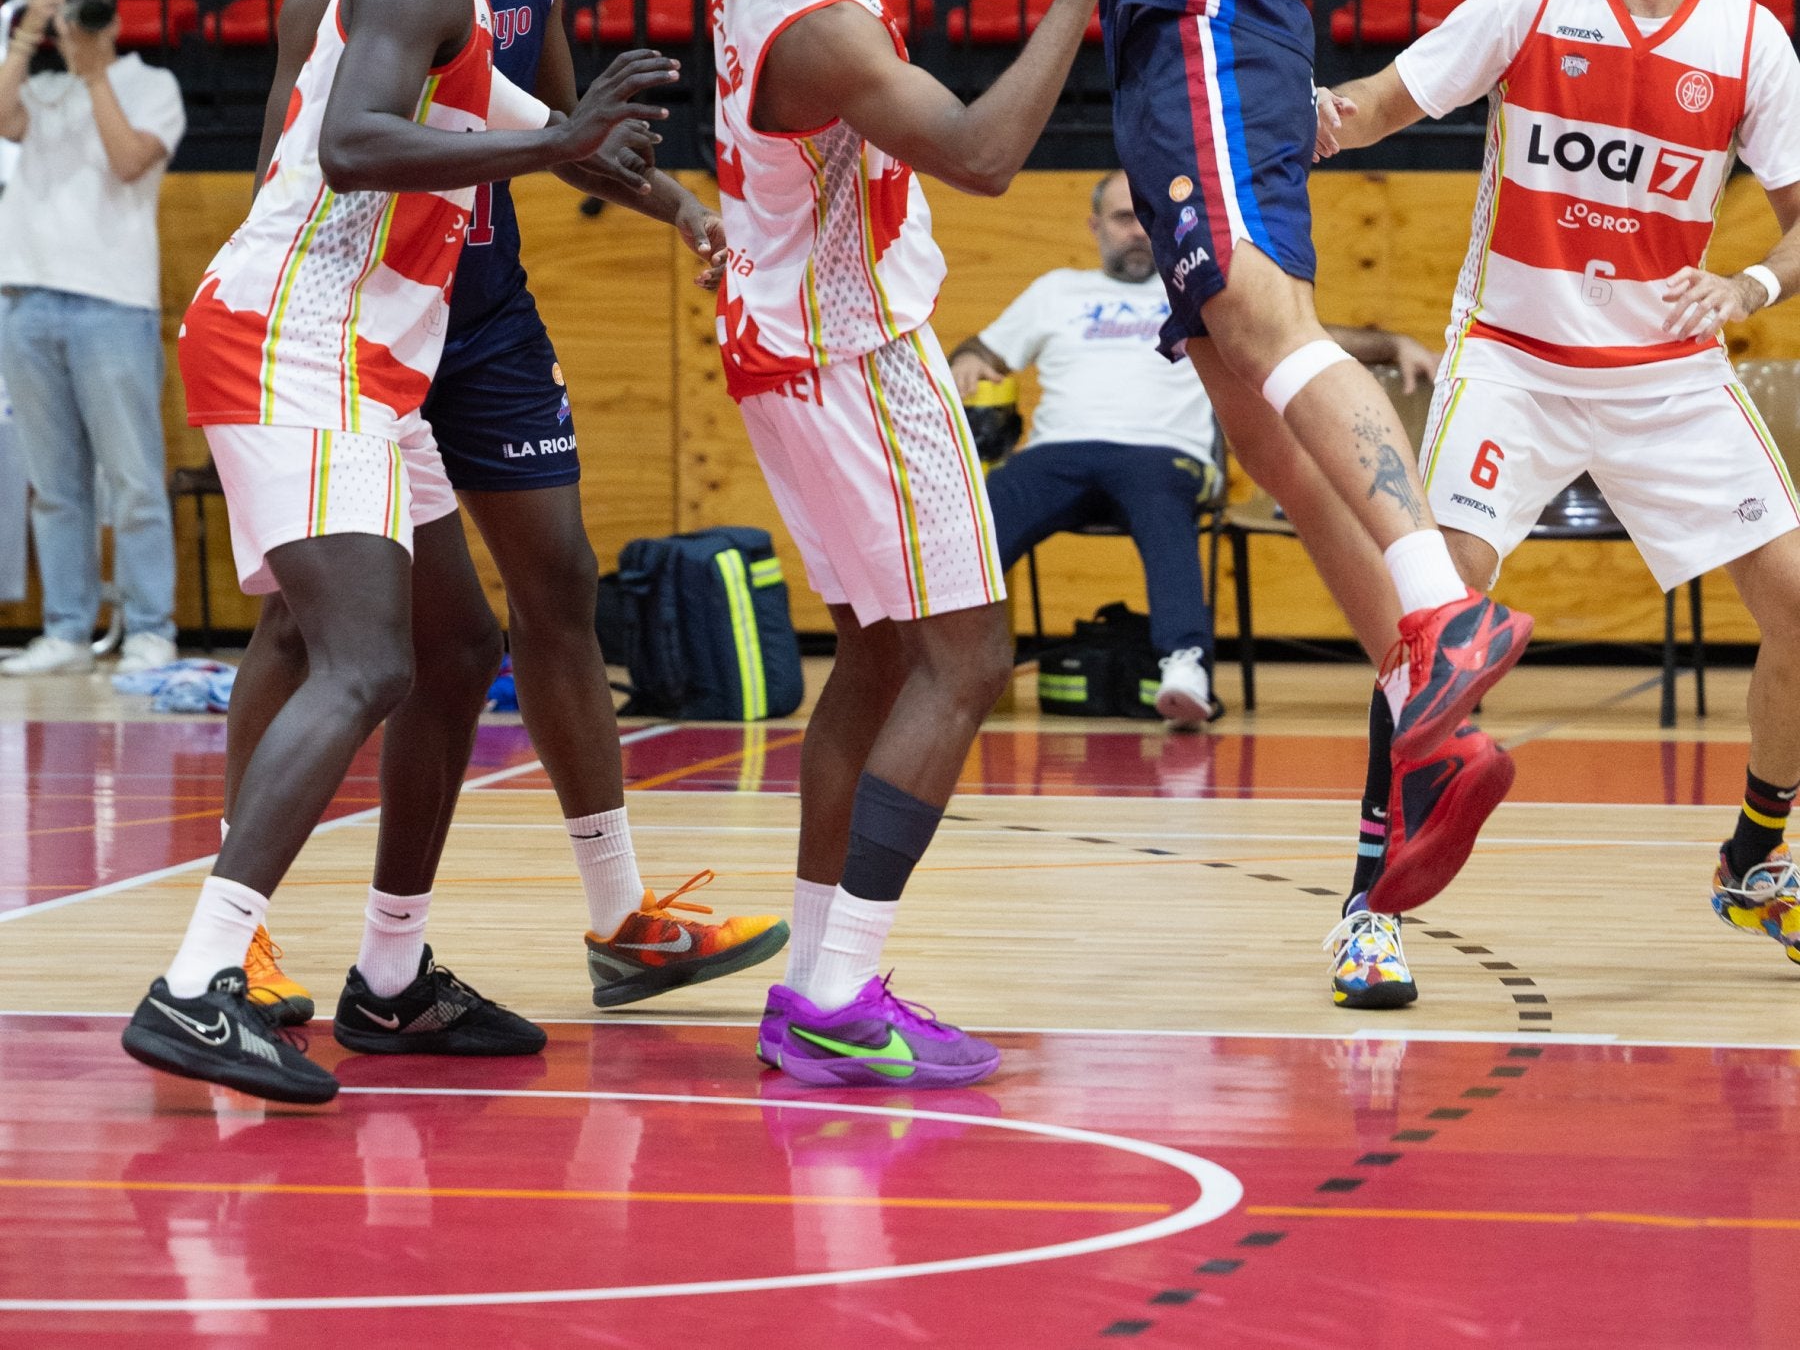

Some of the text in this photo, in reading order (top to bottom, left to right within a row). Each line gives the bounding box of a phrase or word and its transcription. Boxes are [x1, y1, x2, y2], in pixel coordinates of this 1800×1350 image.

[1527, 123, 1645, 184] LOGI
[1580, 259, 1616, 306] 6
[507, 441, 536, 458] LA
[1470, 439, 1505, 491] 6
